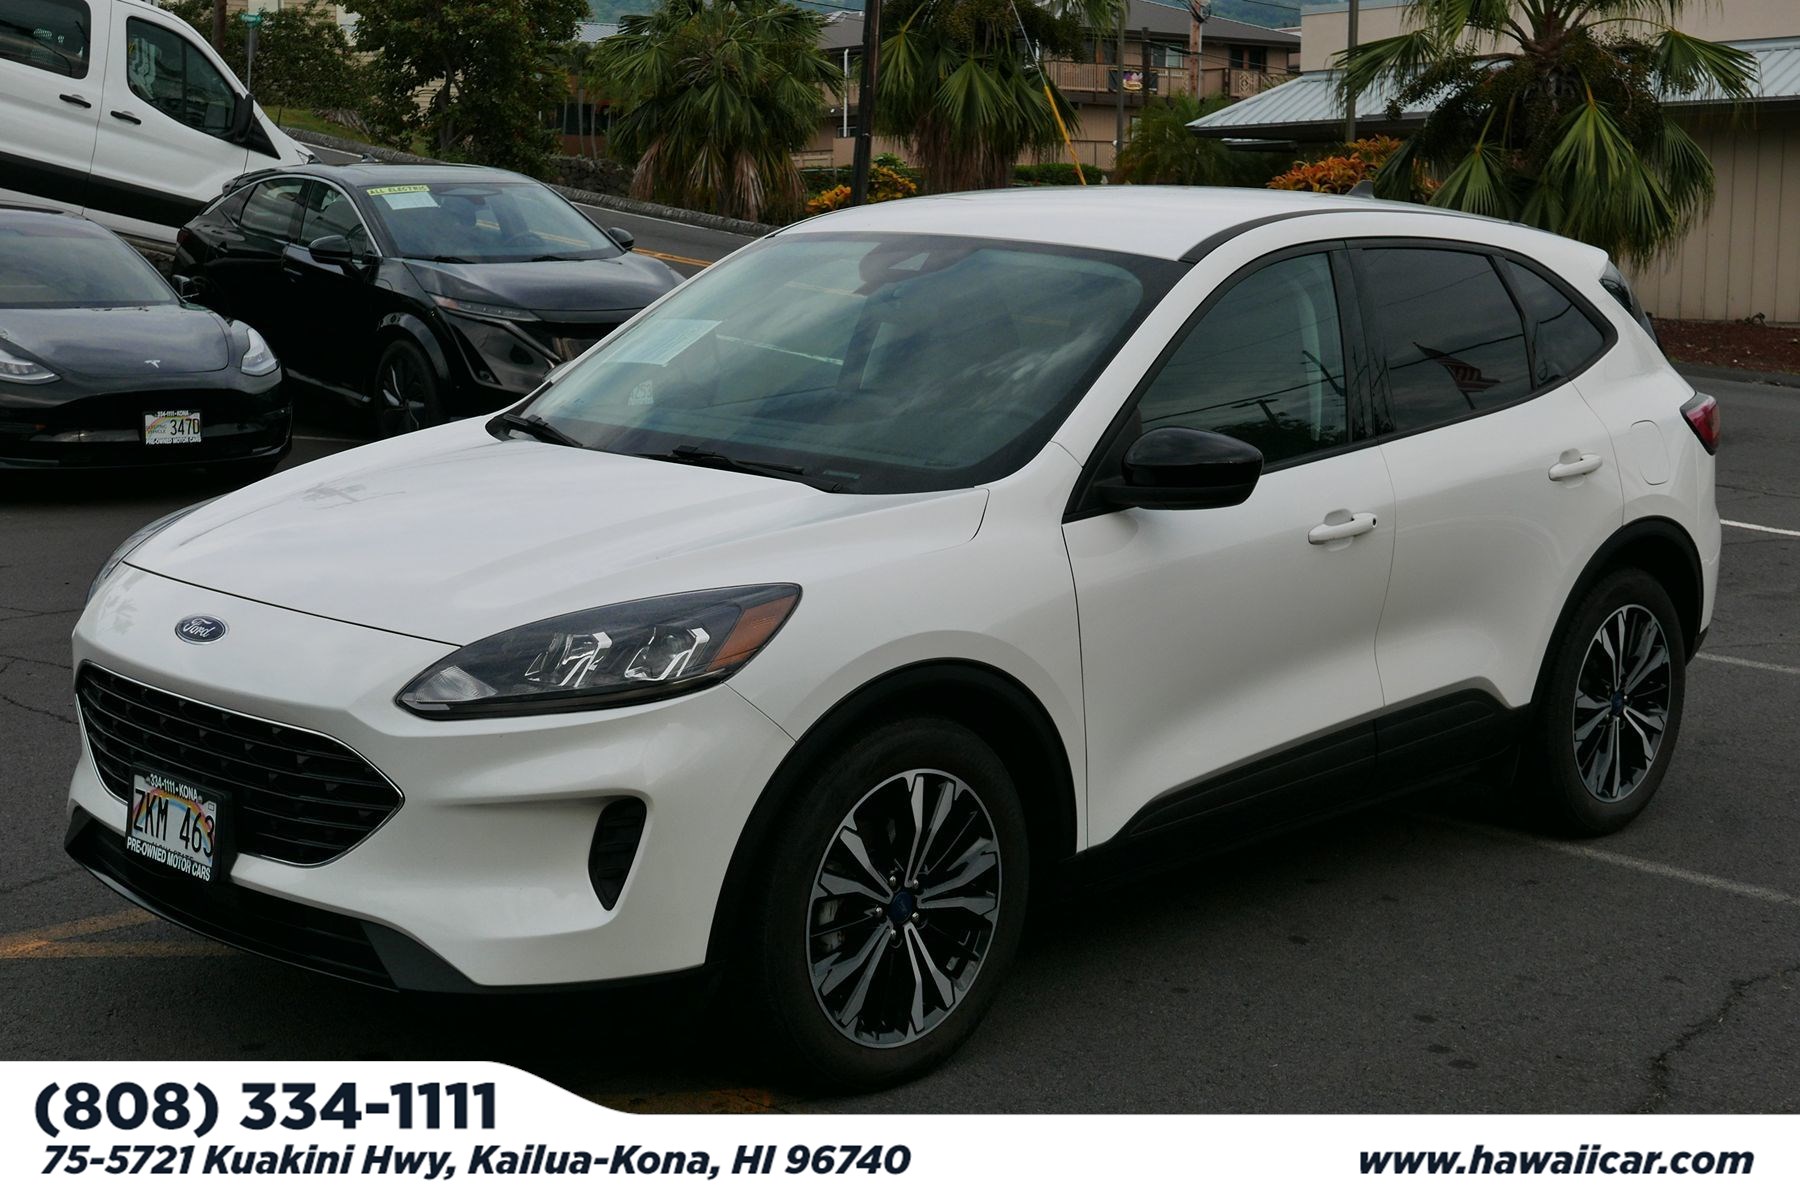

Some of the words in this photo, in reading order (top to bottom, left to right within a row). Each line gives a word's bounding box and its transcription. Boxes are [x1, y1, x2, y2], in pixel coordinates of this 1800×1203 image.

[182, 618, 216, 637] Ford
[179, 783, 197, 802] KONA
[134, 788, 169, 841] ZKM
[179, 806, 215, 858] 463
[127, 836, 166, 863] PRE-OWNED
[167, 853, 190, 874] MOTOR
[191, 862, 211, 881] CARS
